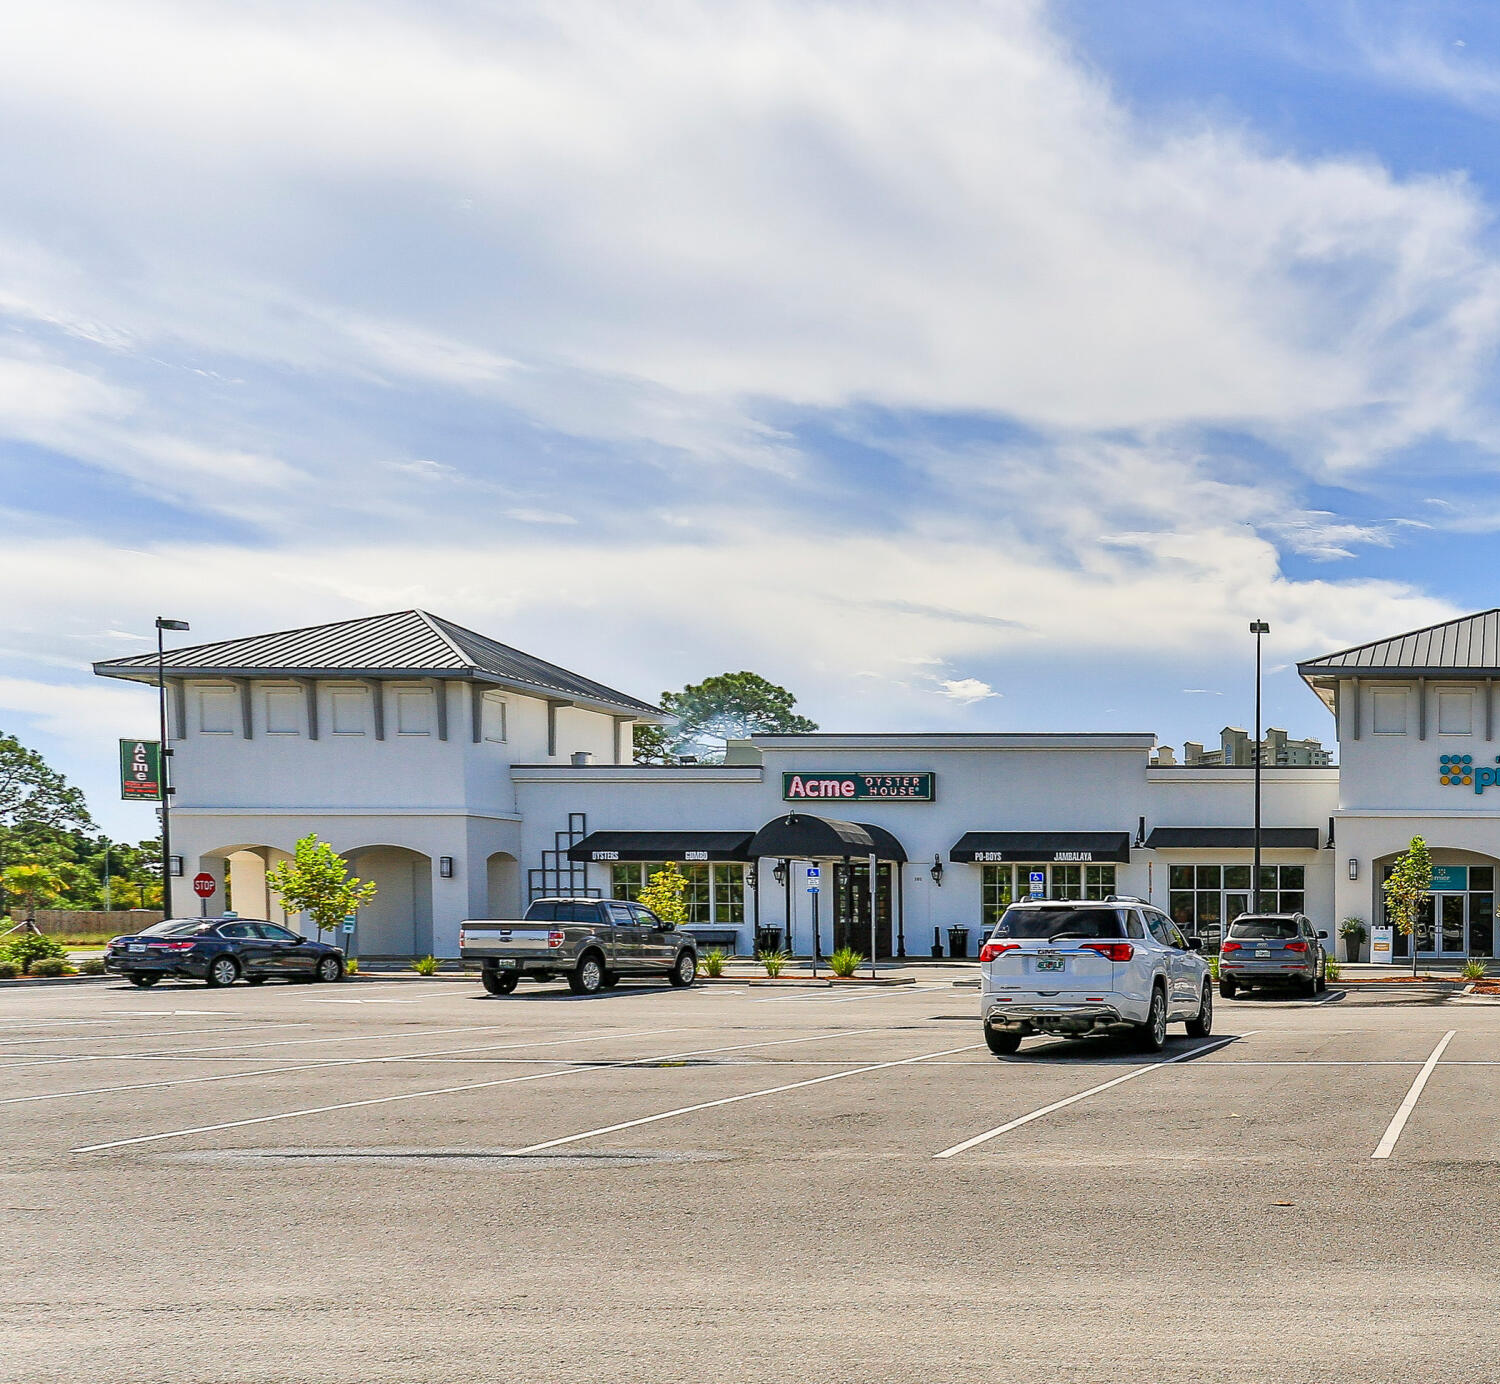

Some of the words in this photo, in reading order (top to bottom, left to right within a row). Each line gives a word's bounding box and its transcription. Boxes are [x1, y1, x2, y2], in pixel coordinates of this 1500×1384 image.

[132, 743, 149, 780] Acme
[789, 775, 855, 797] Acme
[865, 777, 920, 787] OYSTER
[592, 851, 619, 860] OYSTERS
[685, 851, 708, 860] GUMBO
[974, 852, 1002, 861] PO-BOYS
[1053, 852, 1092, 861] JAMBALAYA
[195, 880, 215, 890] STOP
